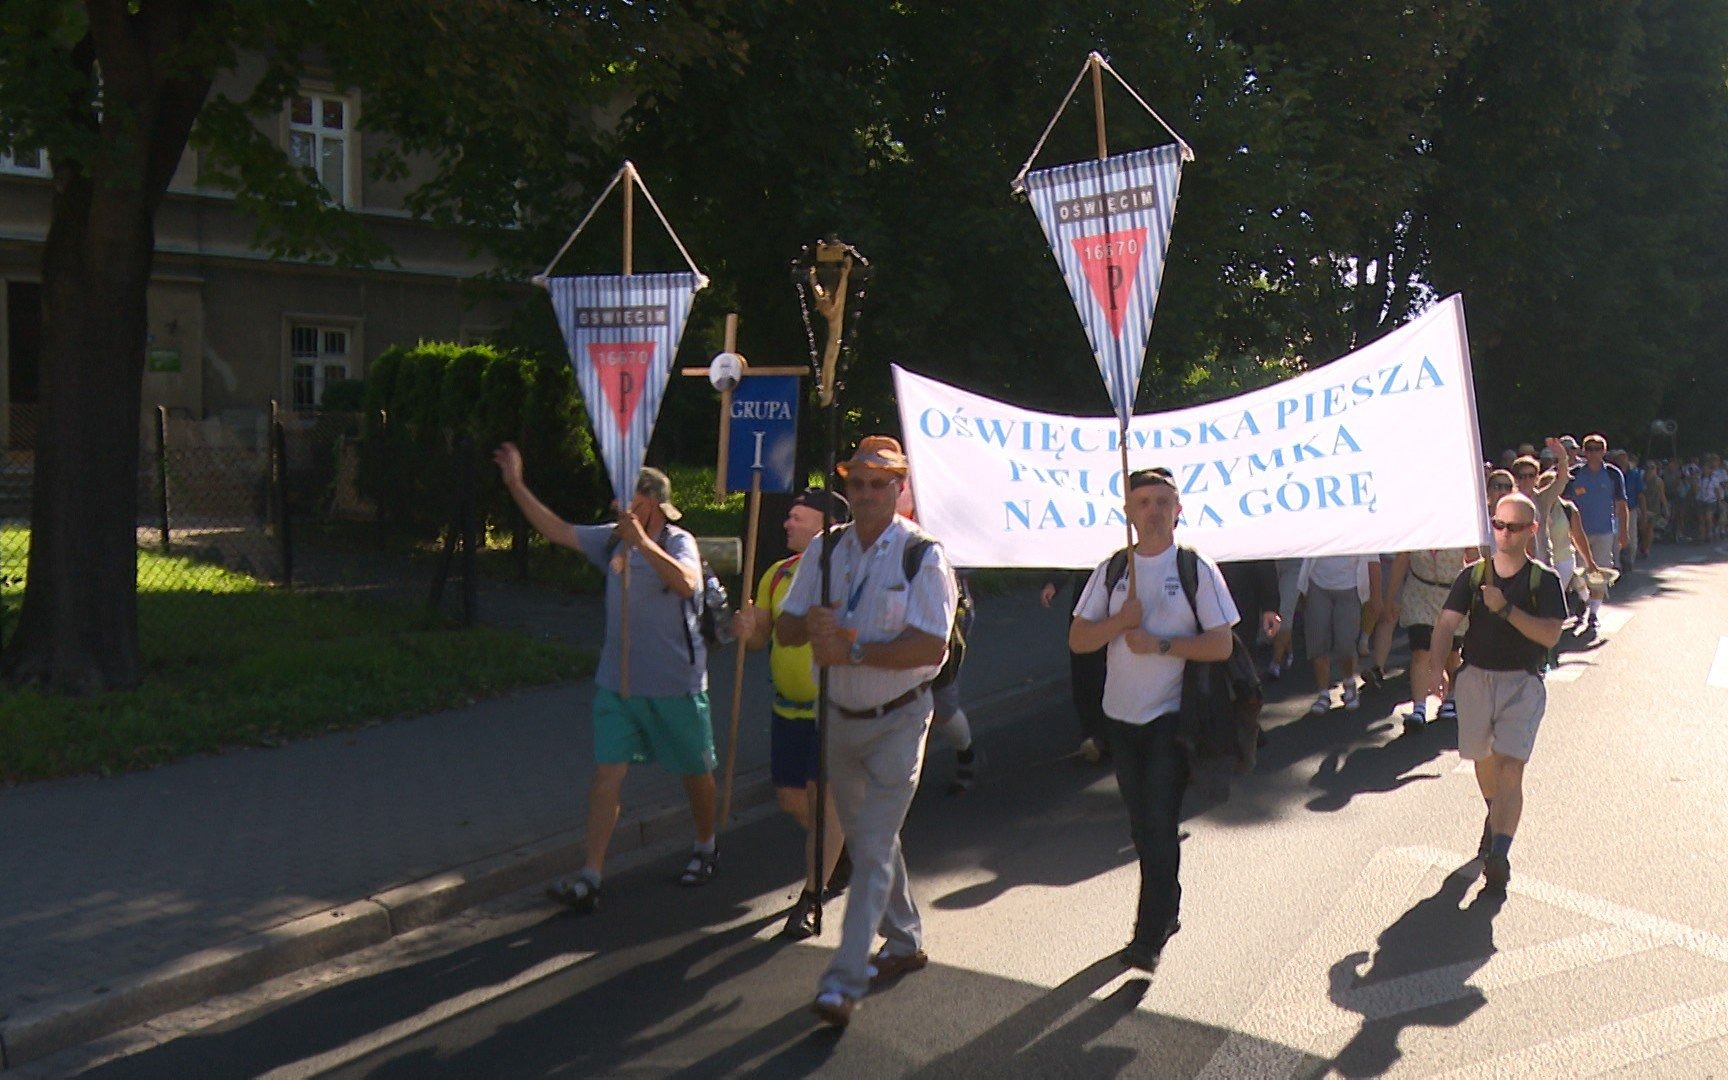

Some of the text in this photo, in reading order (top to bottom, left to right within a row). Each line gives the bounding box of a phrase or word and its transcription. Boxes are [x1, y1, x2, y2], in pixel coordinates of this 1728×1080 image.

[1106, 265, 1123, 311] P
[619, 371, 633, 413] P
[730, 400, 792, 420] GRUPA
[1276, 355, 1445, 429] PIESZA
[1008, 424, 1363, 498] PIELZYMKA
[1003, 498, 1067, 531] NA
[1238, 471, 1377, 514] GÓRĘ
